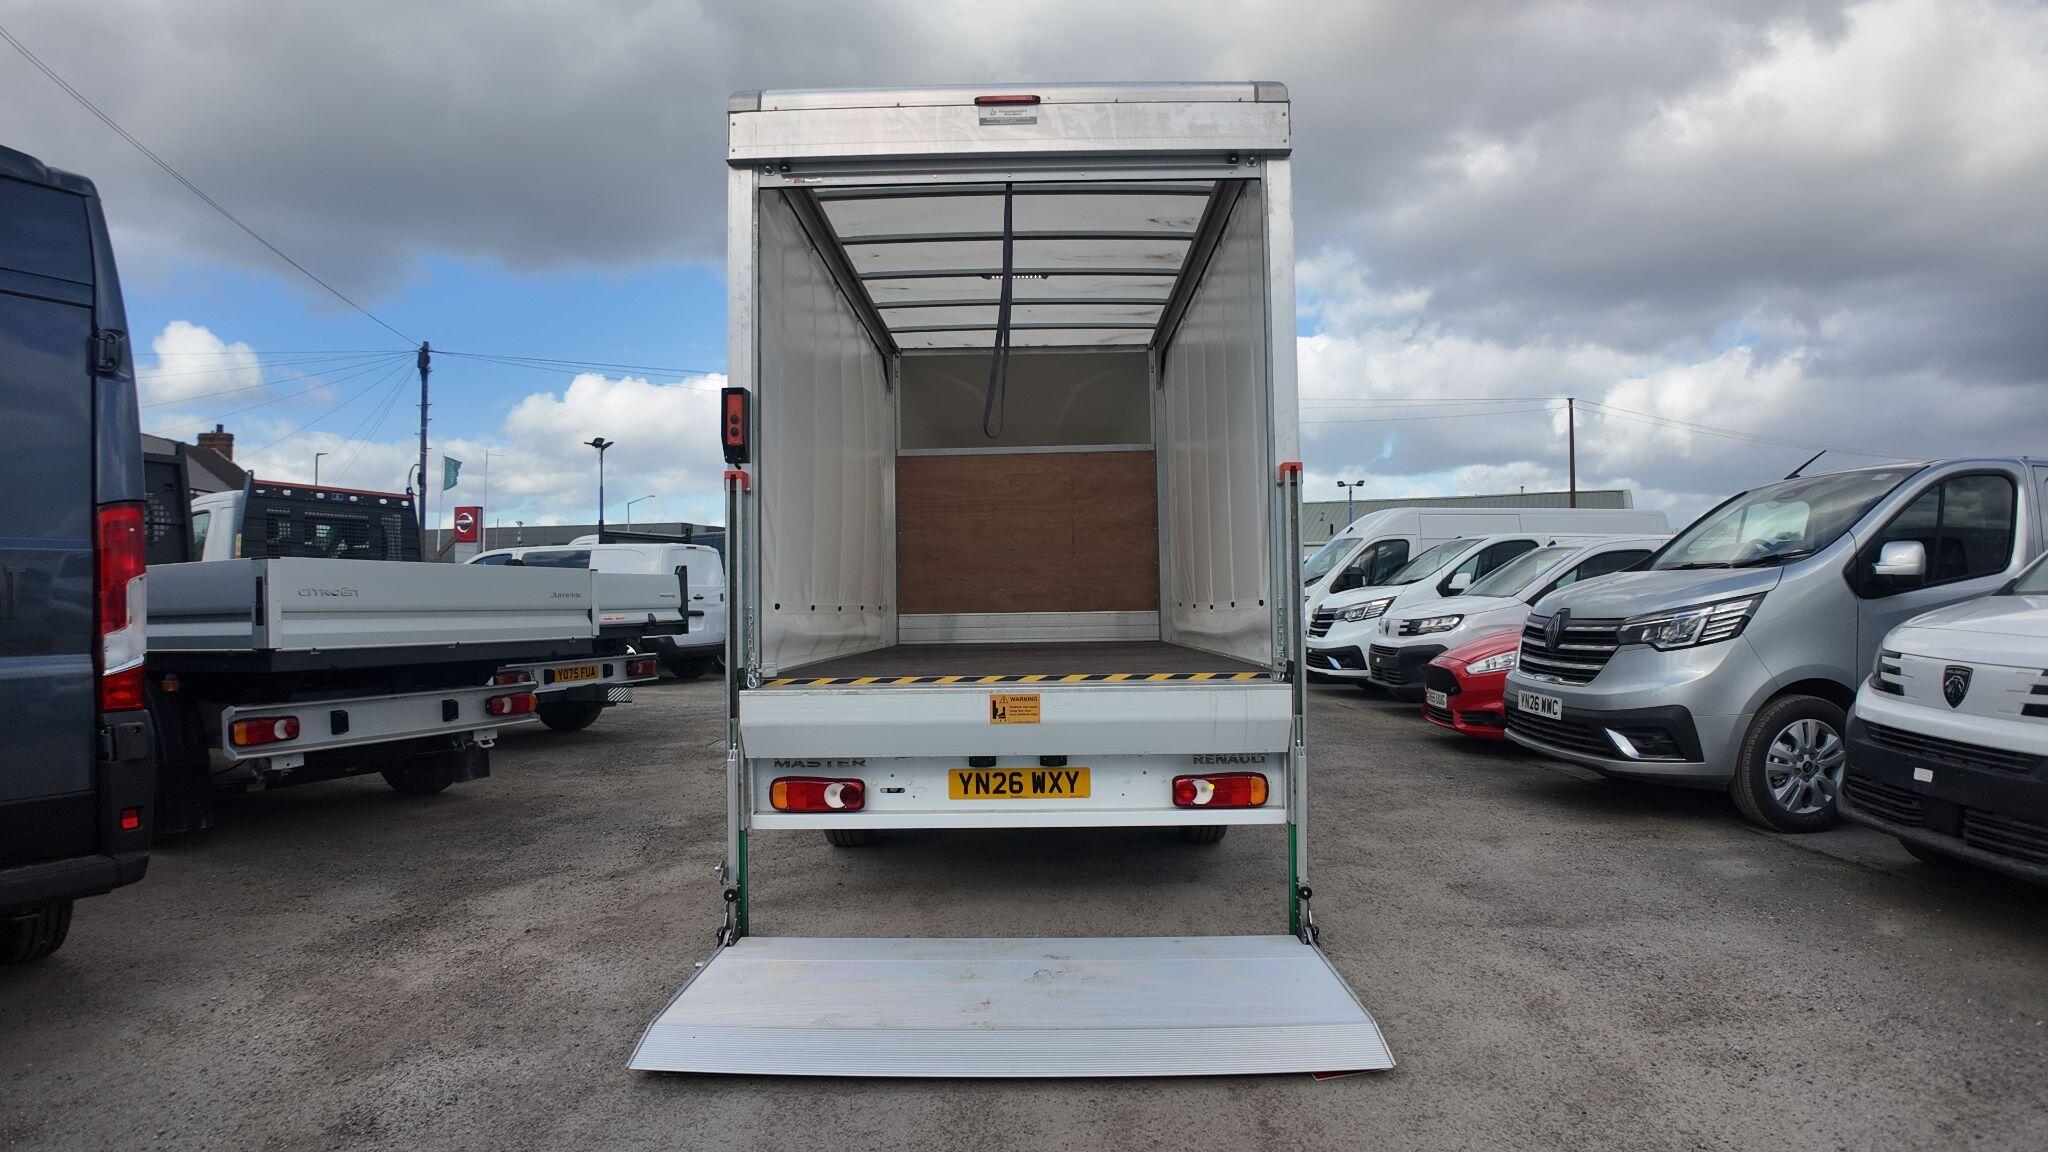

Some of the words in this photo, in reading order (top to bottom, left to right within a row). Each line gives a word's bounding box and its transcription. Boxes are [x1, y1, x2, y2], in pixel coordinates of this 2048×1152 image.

[580, 665, 596, 679] FUA
[1520, 691, 1540, 712] YN26
[774, 758, 867, 768] MASTER
[1193, 752, 1269, 765] RENAULT
[958, 771, 1024, 795] YN26
[1031, 770, 1080, 794] WXY
